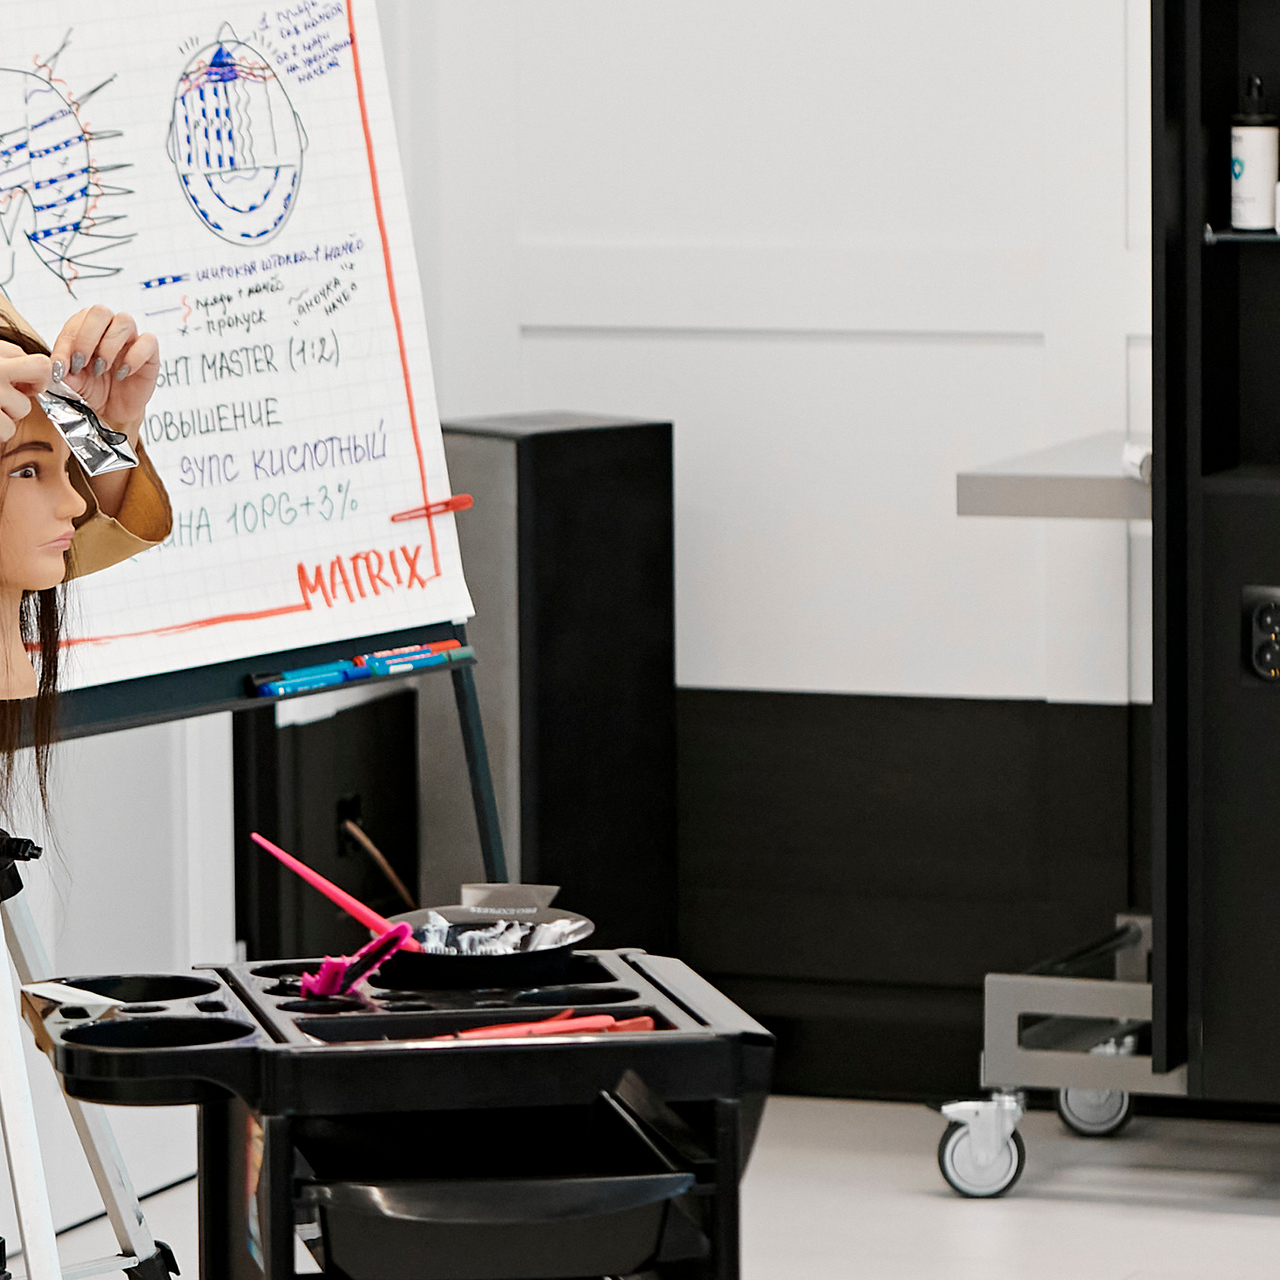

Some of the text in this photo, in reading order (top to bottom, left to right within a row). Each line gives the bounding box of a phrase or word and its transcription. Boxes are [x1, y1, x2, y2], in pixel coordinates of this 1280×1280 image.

[201, 343, 279, 384] MASTER
[289, 328, 340, 372] (1:2)
[251, 419, 387, 481] КИСЛОТНЫЙ
[297, 544, 426, 610] MATRIX
